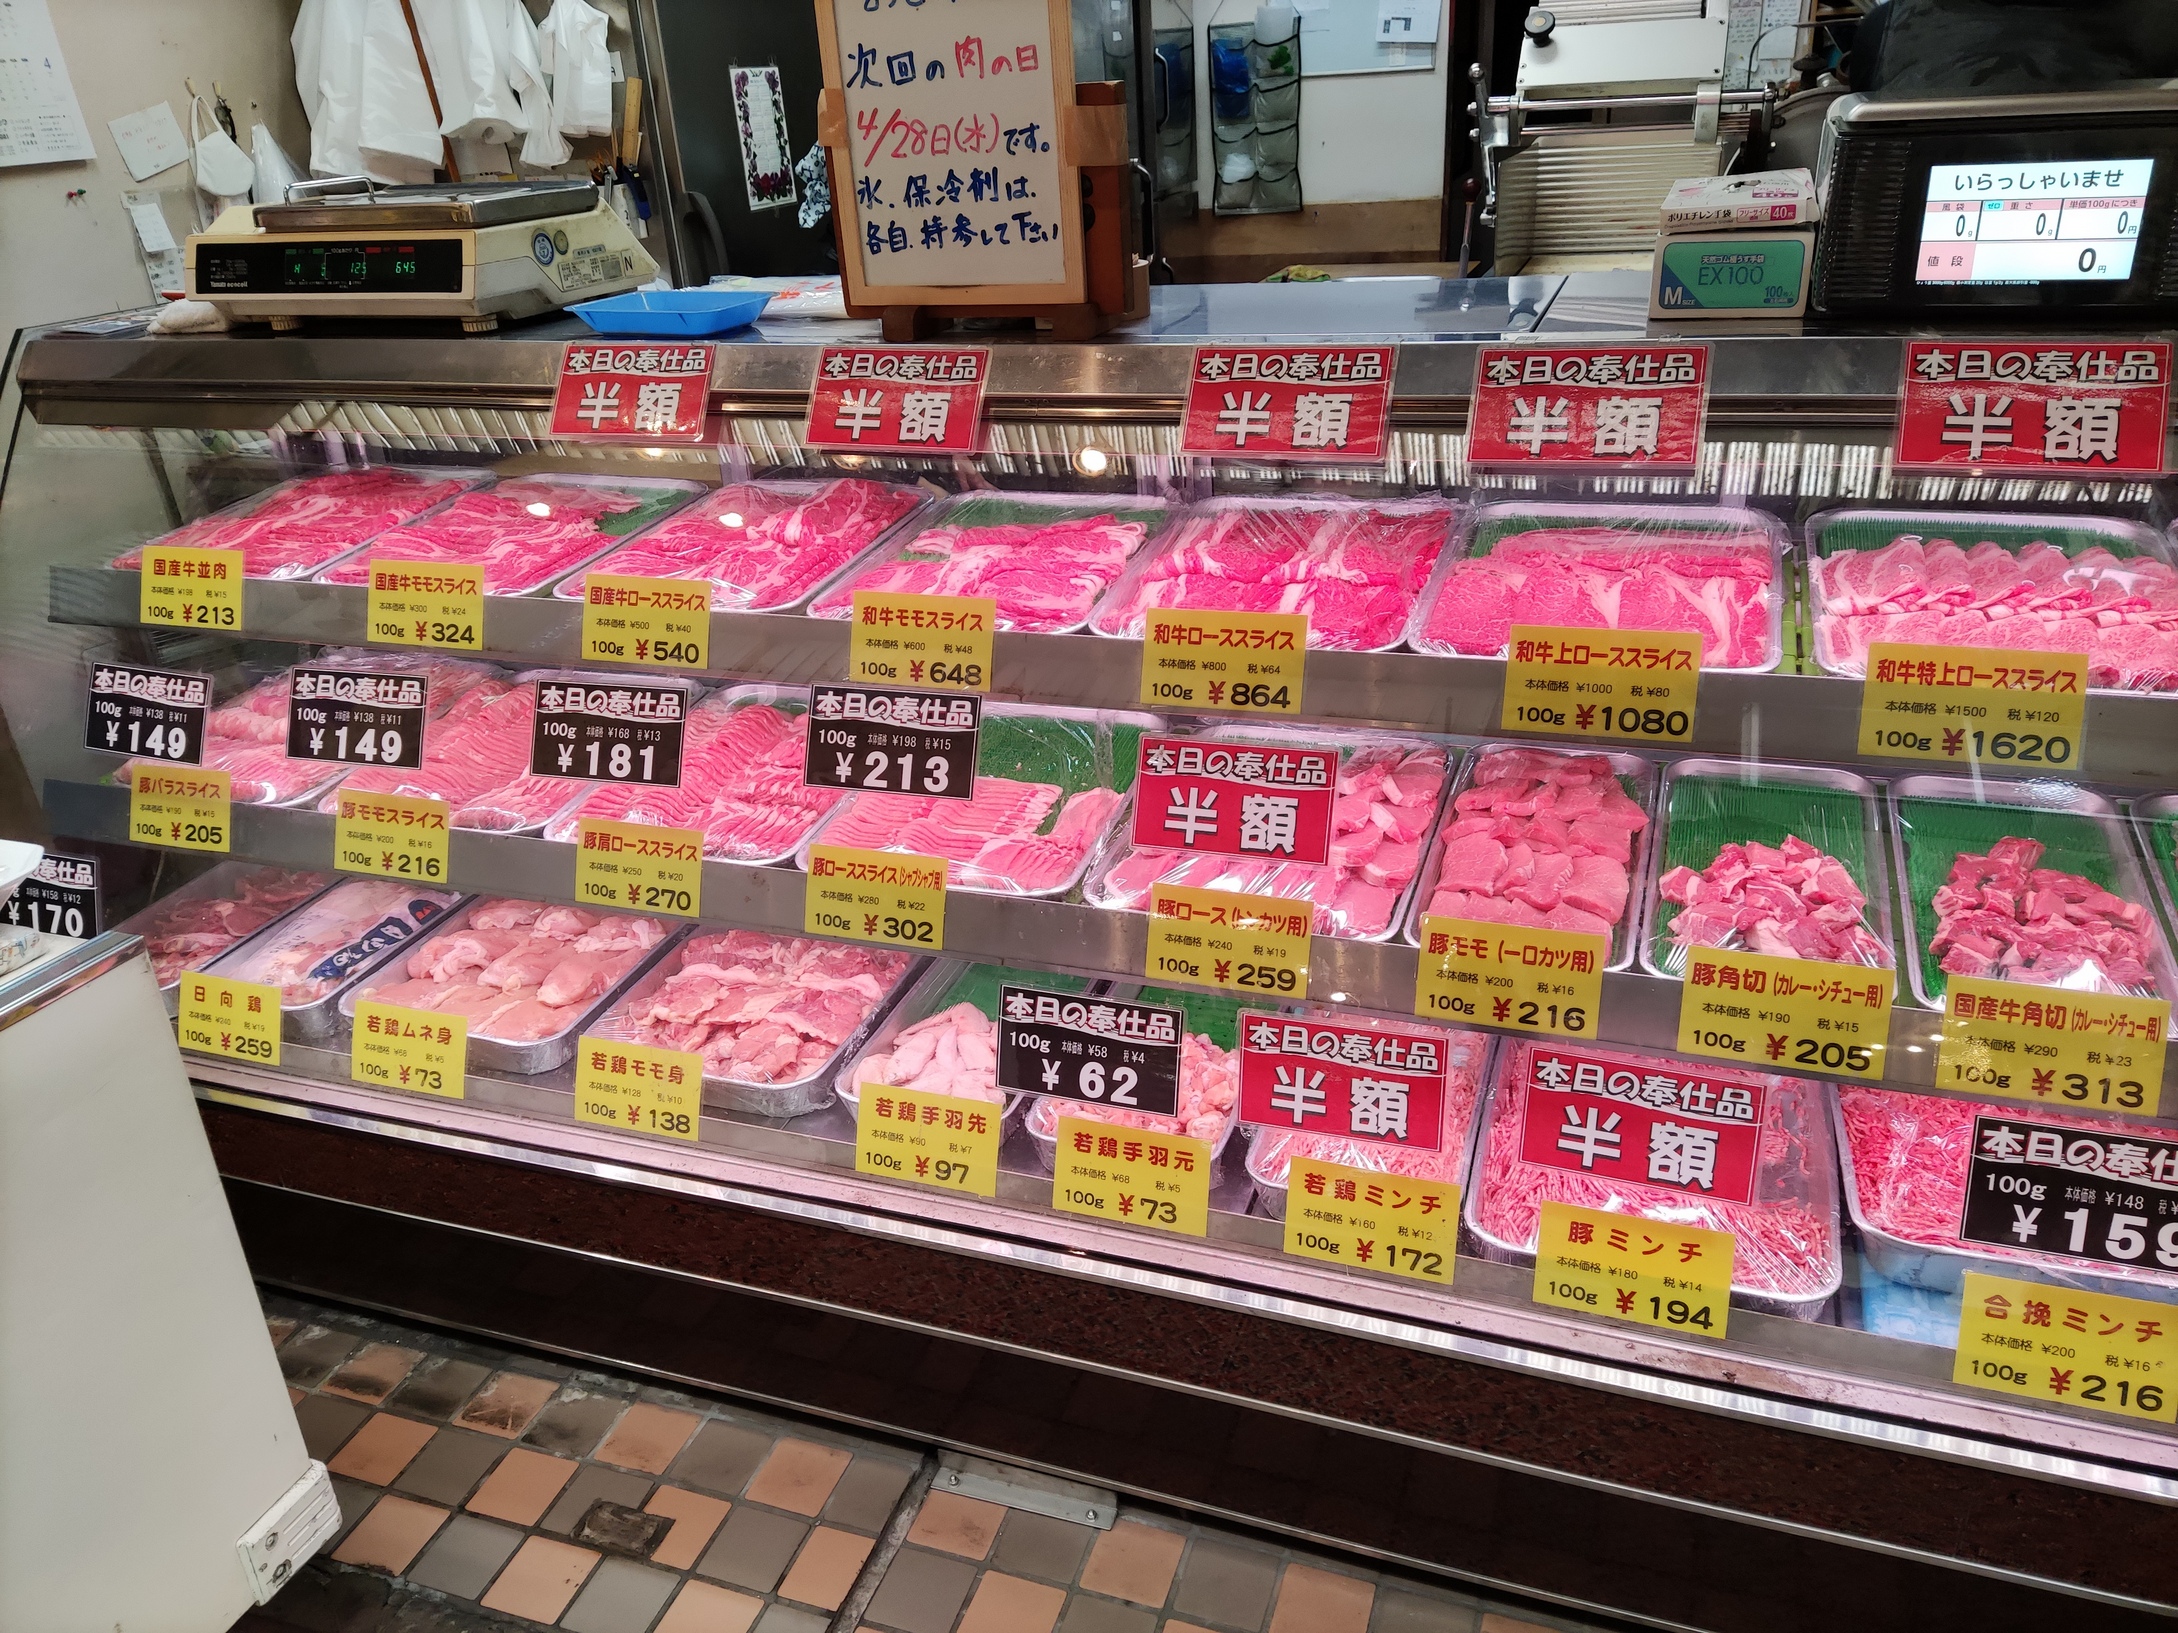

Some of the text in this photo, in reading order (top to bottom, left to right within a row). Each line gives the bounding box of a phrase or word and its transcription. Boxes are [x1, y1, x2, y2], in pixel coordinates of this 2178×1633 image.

[1955, 170, 2124, 190] いらっしゃいませ
[1668, 209, 1731, 222] ポリエチレン手袋
[2010, 202, 2033, 210] 重さ
[2069, 200, 2138, 209] 単価100gにつき
[1927, 255, 1963, 267] 値段
[1665, 286, 1682, 305] M
[569, 349, 706, 372] 本日の奉仕品
[825, 353, 978, 380] 本日の奉仕品
[1201, 353, 1382, 380] 本日の奉仕品
[1487, 354, 1696, 385] 本日の奉仕品
[1916, 349, 2158, 381] 本日の奉仕品
[577, 382, 682, 430] 半額
[835, 389, 951, 443] 半額
[1218, 391, 1352, 448] 半額
[1506, 396, 1662, 455] 半額
[1941, 393, 2122, 463] 半額
[154, 559, 226, 579] 国産牛並肉
[376, 573, 477, 595] 国産牛モモスライス
[590, 586, 705, 611] 国産牛ローススライス
[148, 604, 234, 625] 100g ¥213
[862, 606, 982, 631] 和牛モモスライス
[376, 621, 474, 644] 100g ¥324
[1154, 624, 1294, 650] 和牛ローススライス
[592, 639, 699, 663] 100g ¥540
[1516, 640, 1691, 670] 和牛上ローススライス
[95, 668, 204, 703] 本日の奉仕品
[296, 673, 421, 703] 本日の奉仕品
[861, 660, 981, 685] 100g ¥648
[1525, 679, 1569, 692] 本体価格
[1576, 683, 1612, 693] ¥1000
[1876, 659, 2077, 693] 和牛特上ローススライス
[95, 701, 122, 717] 100g
[542, 686, 680, 717] 本日の奉仕品
[817, 691, 972, 726] 本日の奉仕品
[1152, 681, 1290, 708] 100g ¥864
[1885, 701, 1936, 715] 本体価格
[1945, 704, 1986, 717] ¥1500
[297, 708, 327, 723] 100g
[543, 722, 577, 738] 100g
[1518, 704, 1688, 735] 100g ¥1080
[106, 721, 186, 758] ¥149
[310, 727, 402, 763] ¥149
[819, 729, 856, 747] 100g
[1876, 728, 2070, 763] 100g ¥1620
[558, 742, 654, 780] ¥181
[836, 751, 949, 793] ¥213
[1147, 745, 1326, 784] 本日の奉仕品
[139, 777, 220, 798] 豚バラスライス
[341, 802, 444, 829] 豚モモスライス
[1164, 786, 1298, 855] 半額
[137, 822, 222, 844] 100g ¥205
[583, 831, 697, 861] 豚肩ローススライス
[32, 858, 93, 885] 奉仕品
[343, 851, 440, 876] 100g ¥216
[585, 883, 691, 910] 100g ¥270
[8, 900, 83, 937] ¥170
[815, 913, 933, 942] 100g ¥302
[1159, 957, 1296, 991] 100g ¥259
[1006, 993, 1175, 1041] 本日の奉仕品
[1429, 994, 1585, 1031] 100g ¥216
[186, 1030, 272, 1058] 100g ¥259
[367, 1015, 452, 1045] 若鶏ムネ身
[1010, 1032, 1050, 1053] 100g
[1249, 1022, 1438, 1071] 本日の奉仕品
[1694, 1030, 1872, 1071] 100g ¥205
[360, 1062, 442, 1089] 100g ¥73
[591, 1052, 684, 1084] 若鶏モモ身
[1042, 1059, 1138, 1106] ¥62
[1536, 1058, 1753, 1120] 本日の奉仕品
[1954, 1065, 2143, 1108] 100g ¥313
[585, 1102, 690, 1134] 100g ¥138
[876, 1097, 986, 1134] 若鶏手羽先
[1271, 1066, 1409, 1140] 半額
[1074, 1132, 1194, 1172] 若鶏手羽元
[1557, 1105, 1718, 1191] 半額
[866, 1152, 969, 1184] 100g ¥97
[1304, 1172, 1441, 1214] 若鶏ミンチ
[1986, 1173, 2047, 1200] 100g
[1065, 1189, 1177, 1224] 100g ¥73
[1297, 1233, 1442, 1276] 100g ¥172
[1568, 1221, 1702, 1263] 豚ミンチ
[1550, 1281, 1713, 1330] 100g ¥194
[1984, 1294, 2163, 1342] 合挽ミンチ
[1981, 1333, 2032, 1352] 本体価格
[2041, 1344, 2075, 1358] ¥200
[1972, 1360, 2163, 1412] 100g ¥216
